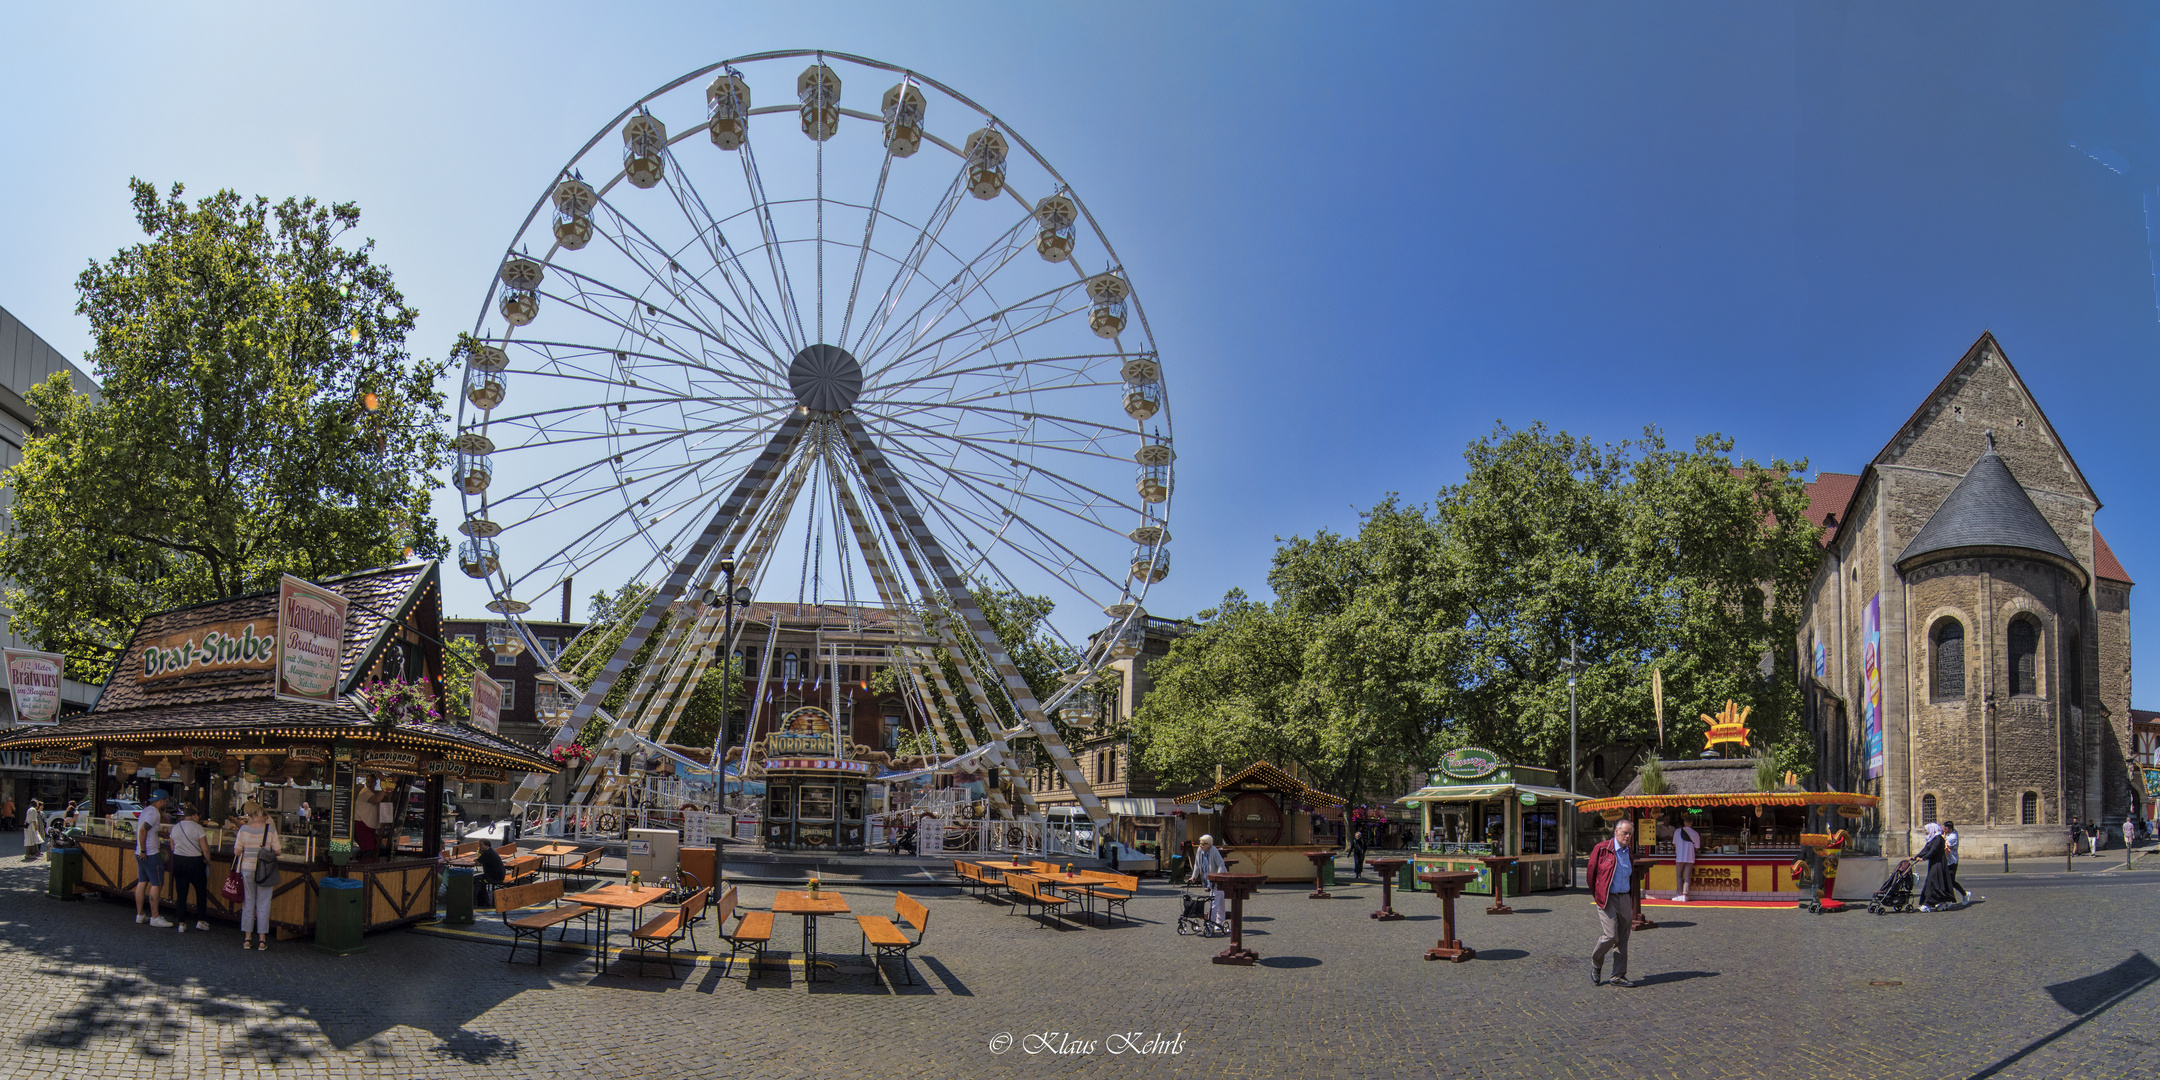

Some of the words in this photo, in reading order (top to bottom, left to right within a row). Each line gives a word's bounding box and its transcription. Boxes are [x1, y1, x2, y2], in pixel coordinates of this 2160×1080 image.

[285, 597, 340, 640] Mantaplatte
[142, 623, 274, 677] Brat-Stube
[287, 632, 336, 663] Bratcurry
[33, 663, 52, 672] Meter
[286, 655, 296, 663] mit
[297, 655, 317, 668] Pommes
[12, 669, 59, 688] Bratwurst
[320, 672, 332, 681] oder
[297, 678, 322, 691] Ketchup
[27, 687, 57, 697] Baguette
[288, 745, 310, 758] Pmmes
[768, 735, 851, 758] NORDERNEE
[42, 748, 81, 760] Champignons
[192, 746, 207, 760] Hot
[208, 746, 224, 762] Dog
[364, 750, 416, 764] Champignons
[428, 760, 445, 773] Hot
[448, 760, 465, 775] Dog
[1687, 807, 1703, 815] Vegan
[1691, 868, 1731, 877] LEONS
[1690, 878, 1741, 887] HURROS
